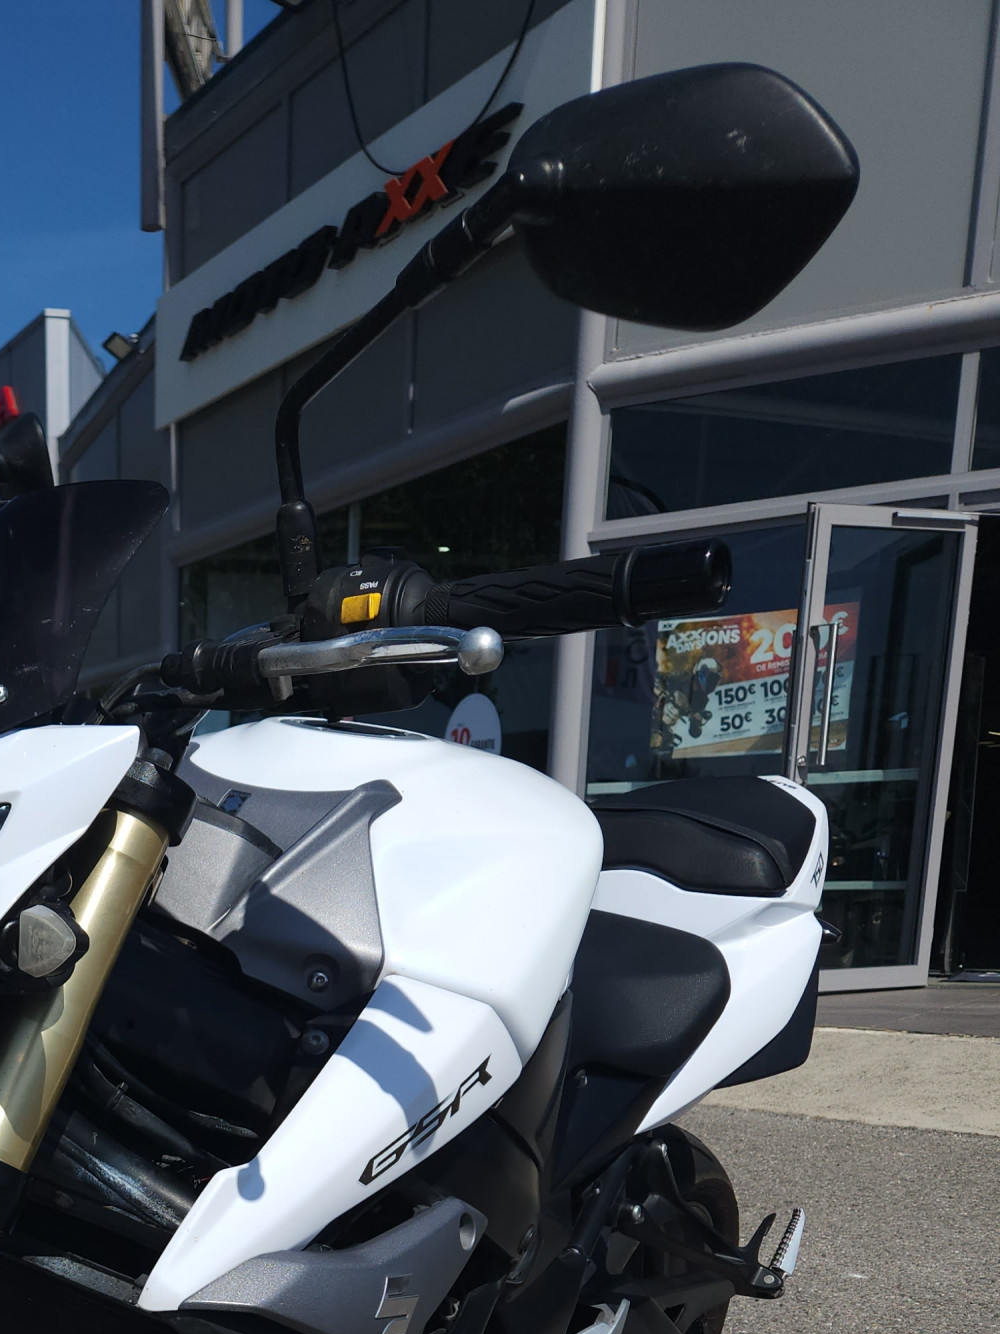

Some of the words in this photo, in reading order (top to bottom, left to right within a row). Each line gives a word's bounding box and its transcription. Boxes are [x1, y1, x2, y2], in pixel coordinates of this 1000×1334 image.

[359, 581, 379, 590] PASS
[767, 660, 791, 670] REMIS
[714, 683, 756, 706] 150€
[720, 711, 752, 732] 50€
[358, 1053, 493, 1186] GSR
